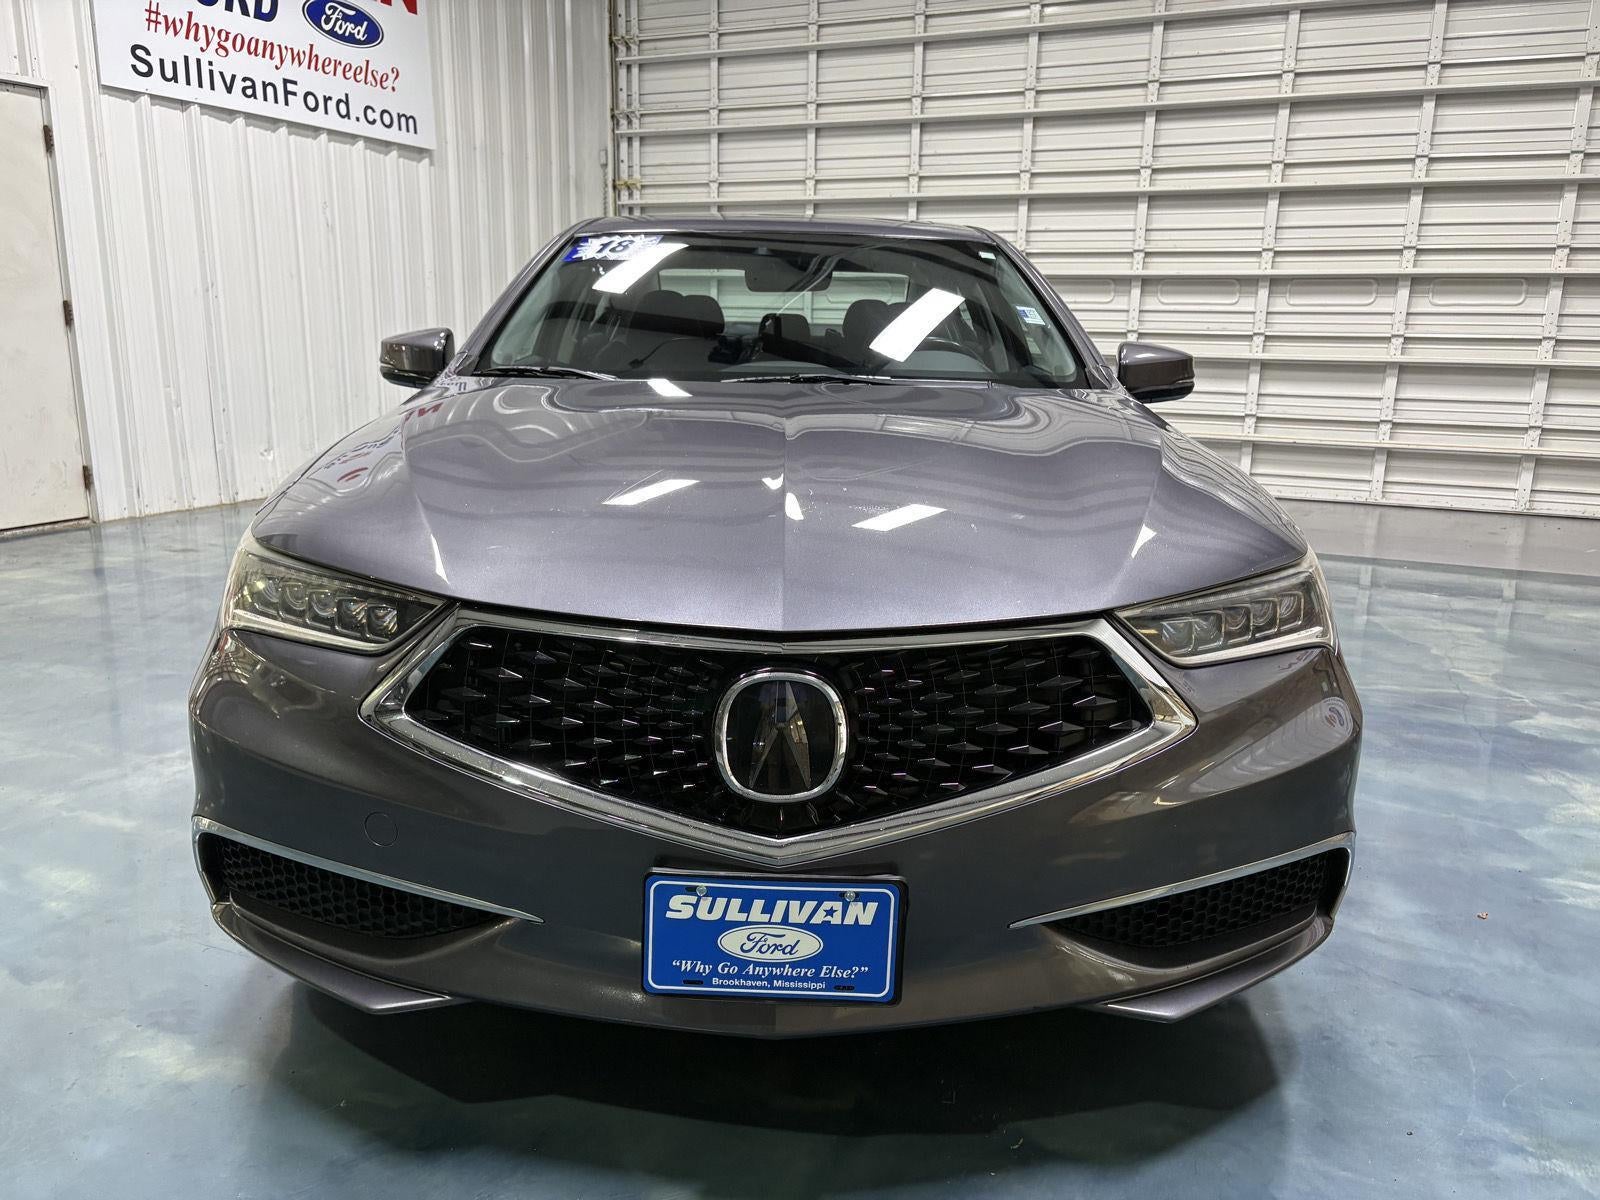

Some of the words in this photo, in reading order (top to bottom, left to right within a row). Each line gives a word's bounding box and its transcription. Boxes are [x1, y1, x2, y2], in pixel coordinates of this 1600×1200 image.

[321, 2, 367, 42] Ford
[144, 1, 400, 92] #whygoanywhereelse?
[130, 43, 418, 135] SullivanFord.com
[665, 894, 878, 925] SULLIVAN
[740, 931, 800, 956] Ford
[712, 977, 771, 988] Brookhaven,
[773, 980, 826, 990] Mississippi
[717, 961, 738, 975] Go
[743, 963, 815, 978] Anywhere
